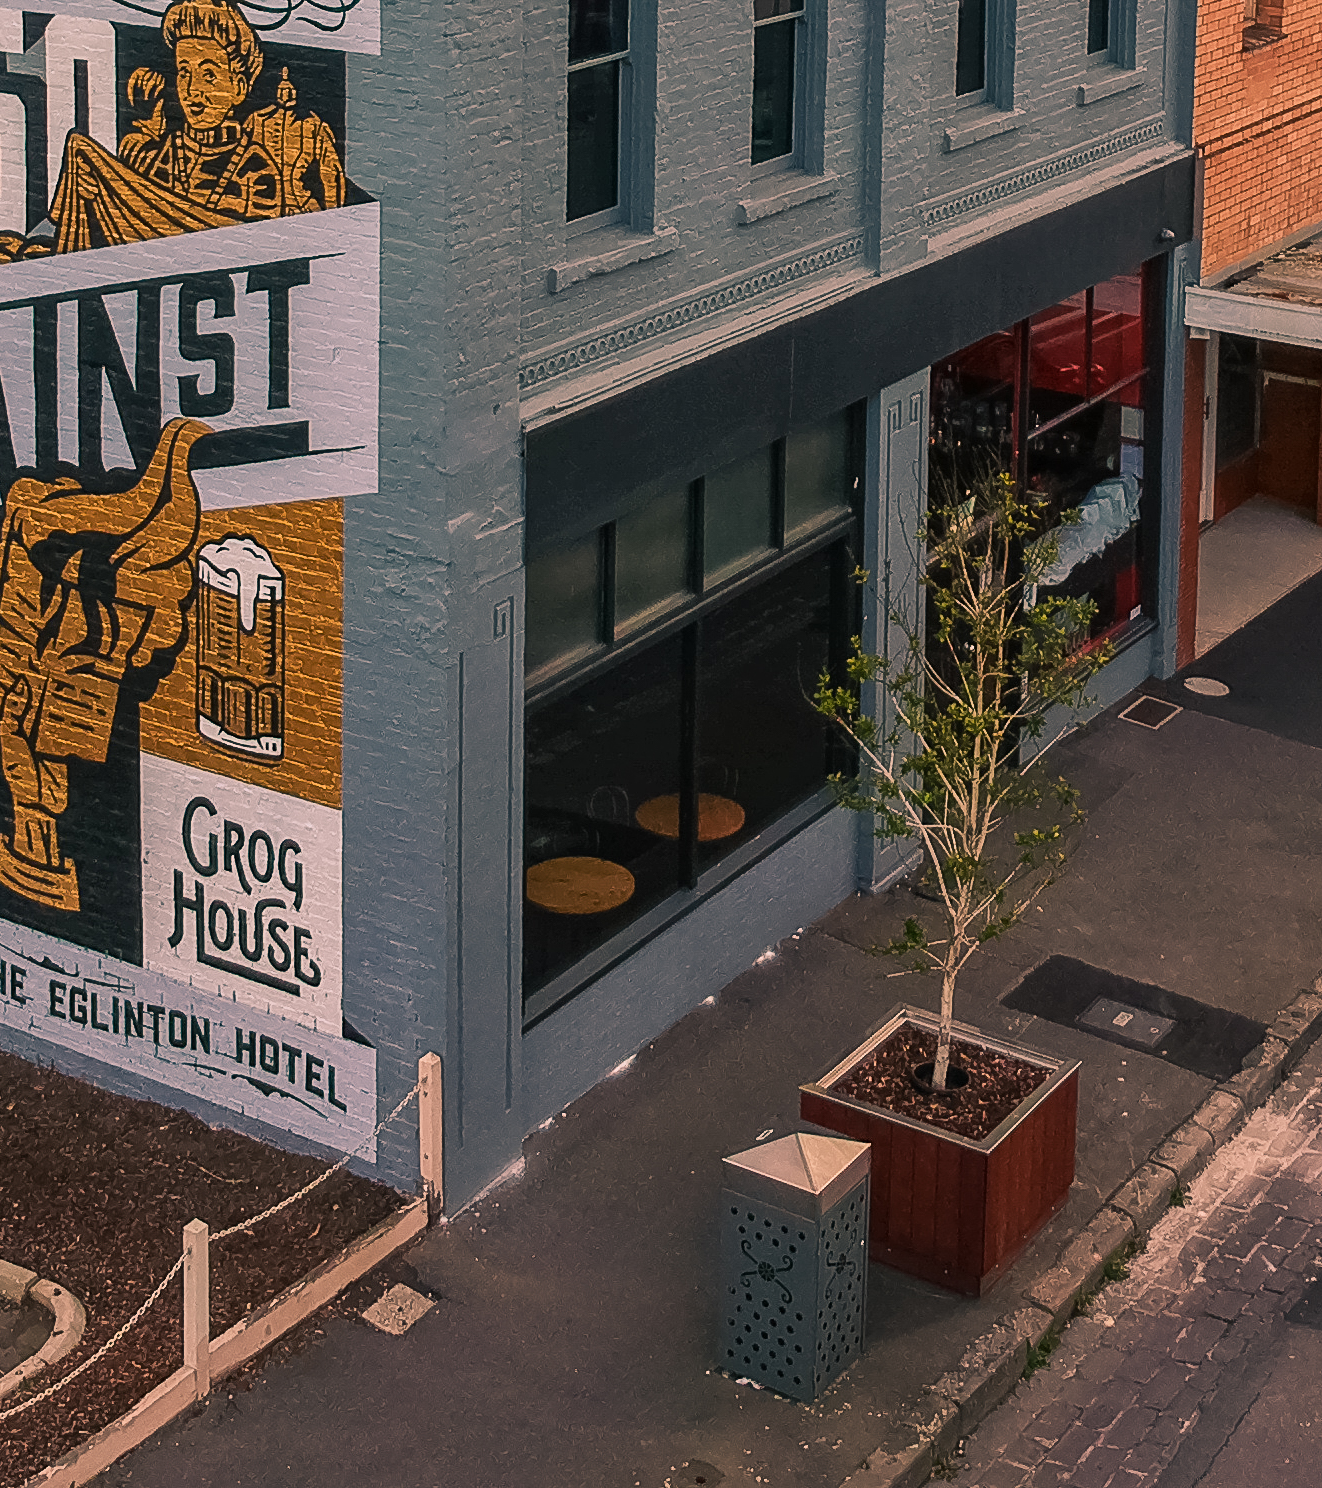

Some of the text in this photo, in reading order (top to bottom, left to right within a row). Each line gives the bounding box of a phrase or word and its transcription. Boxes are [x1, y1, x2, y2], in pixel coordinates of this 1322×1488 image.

[182, 796, 304, 912] GROG
[168, 867, 323, 996] HOUSE
[49, 981, 213, 1057] EGLINTON
[234, 1027, 348, 1113] HOTEL
